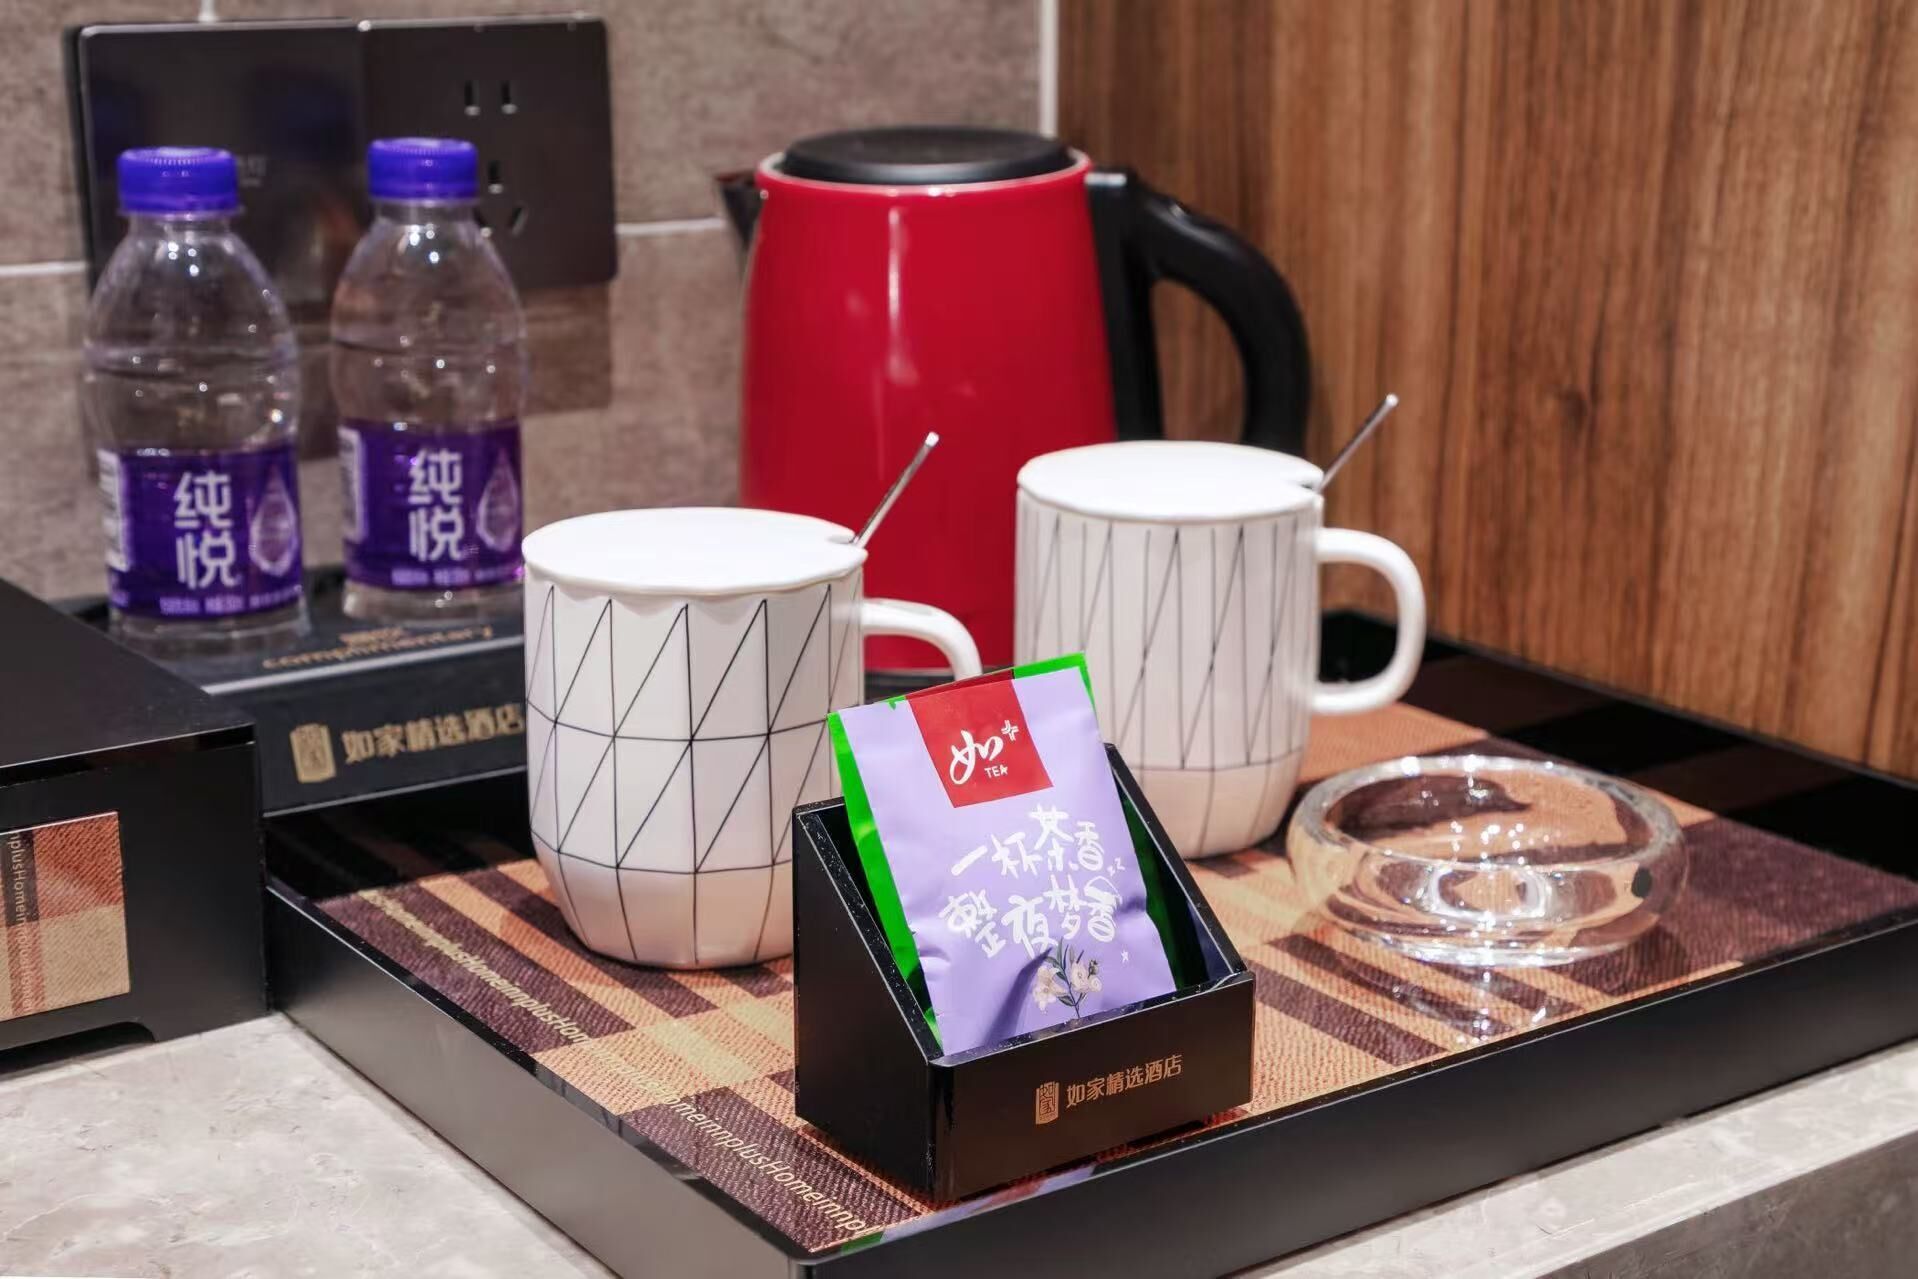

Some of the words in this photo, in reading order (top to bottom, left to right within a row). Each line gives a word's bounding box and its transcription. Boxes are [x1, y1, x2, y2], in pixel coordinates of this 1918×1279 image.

[174, 470, 238, 589] 纯悦
[407, 449, 464, 562] 纯悦
[341, 703, 527, 765] 如家精选酒店
[951, 803, 1104, 880] 一杯茶香
[1066, 1054, 1183, 1109] 如家精选酒店
